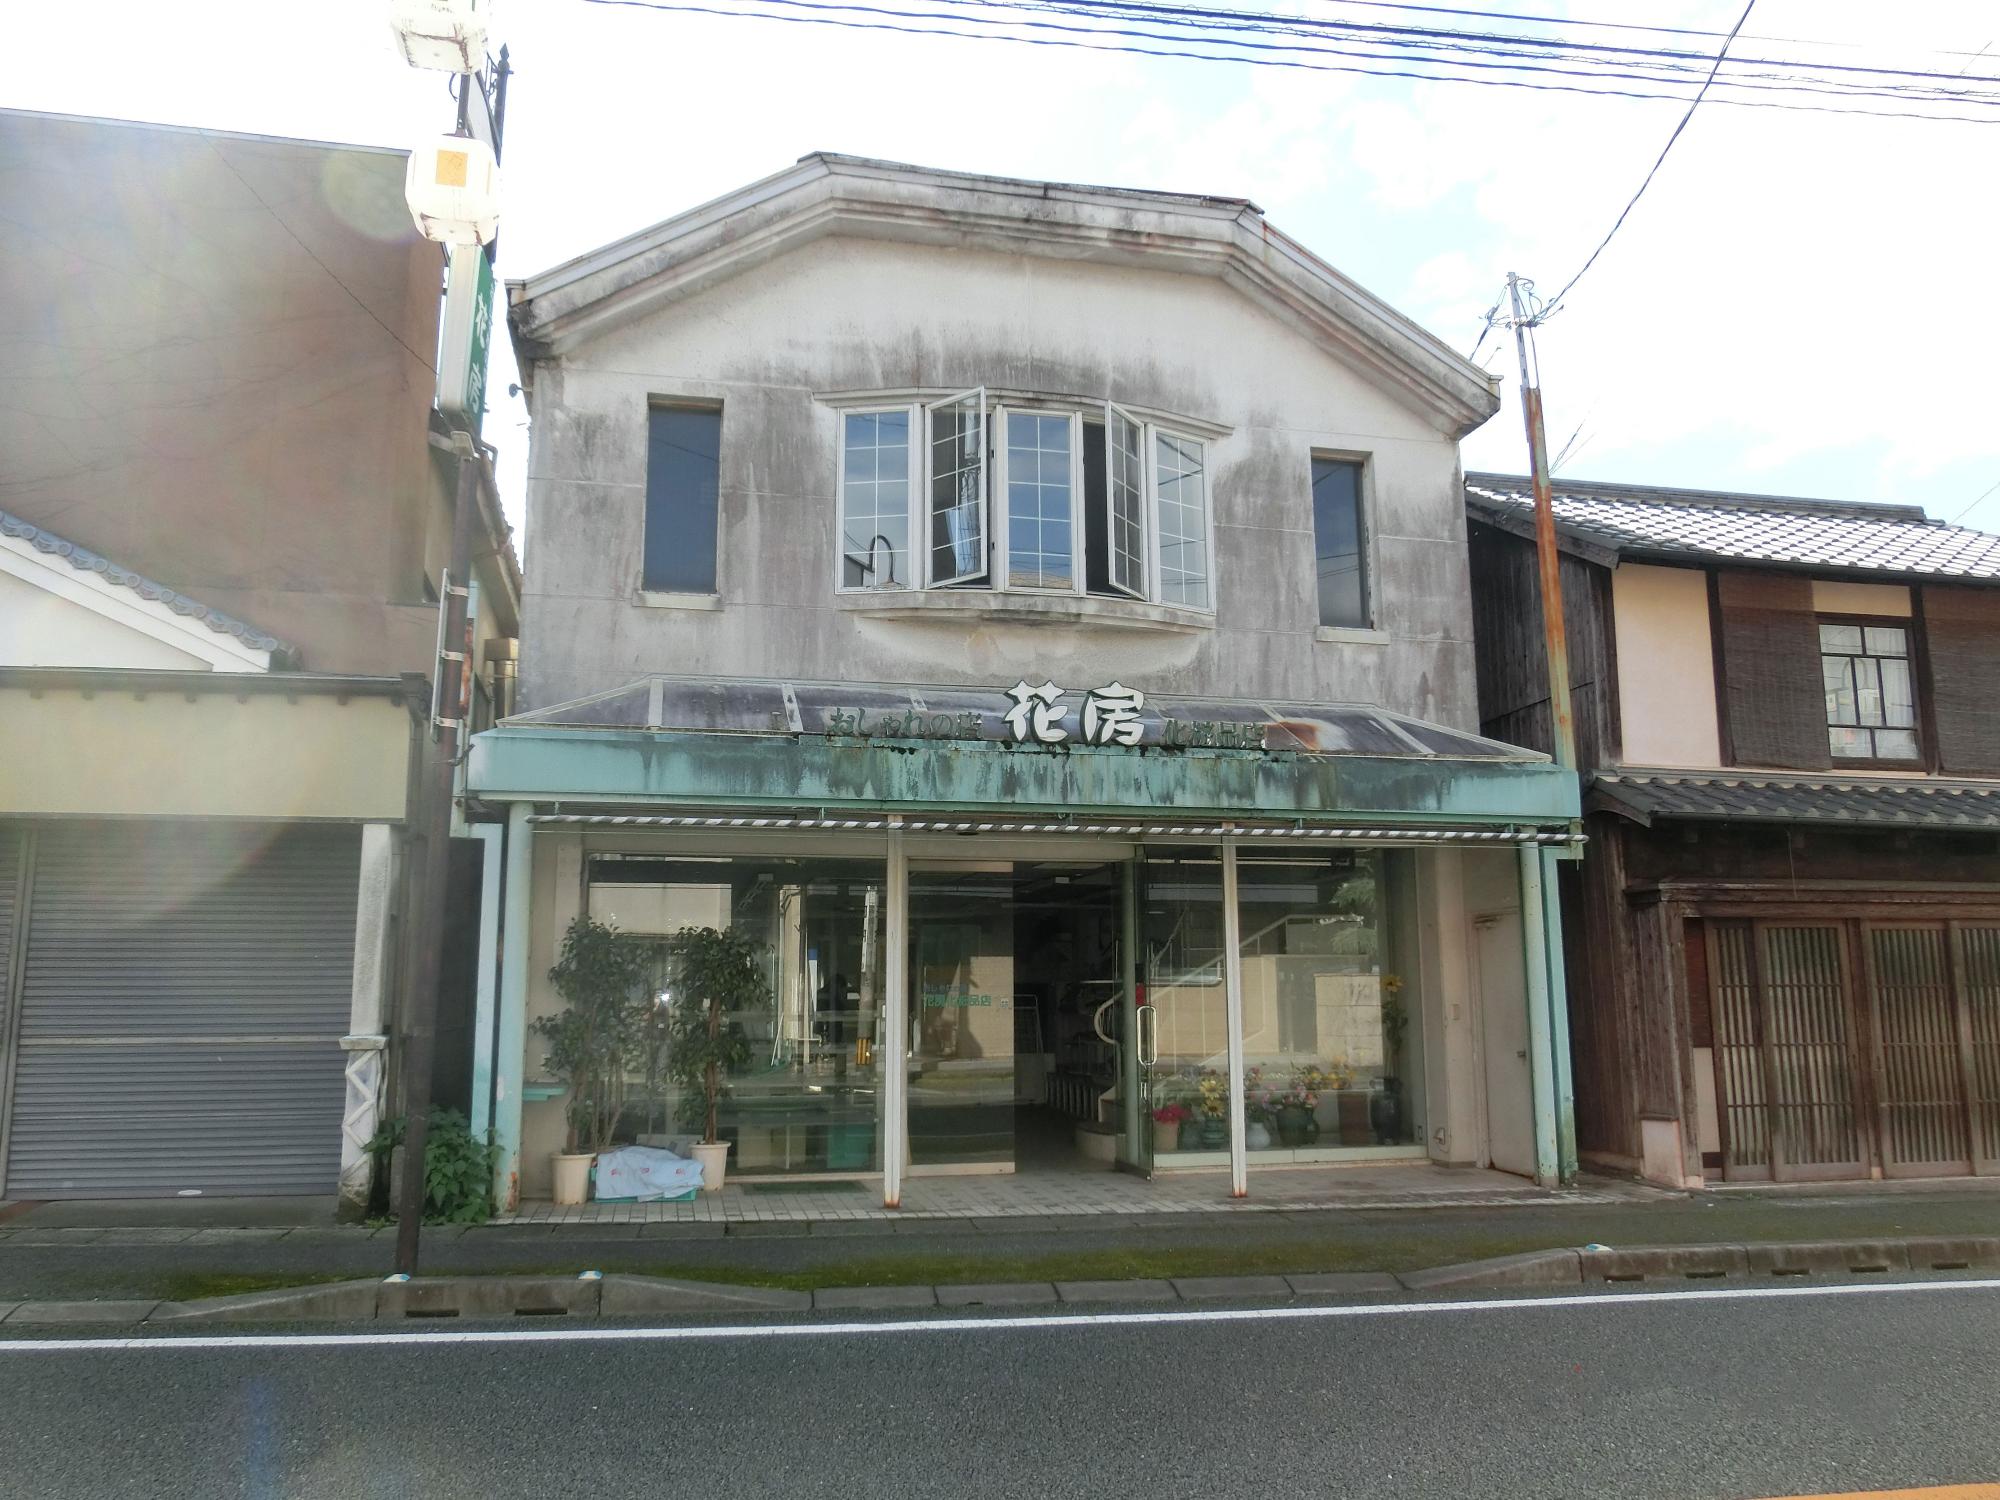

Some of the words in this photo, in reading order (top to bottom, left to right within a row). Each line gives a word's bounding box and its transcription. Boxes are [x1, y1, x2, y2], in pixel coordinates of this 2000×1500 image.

[1003, 679, 1145, 746] 花房
[1163, 718, 1267, 750] 化粧品店
